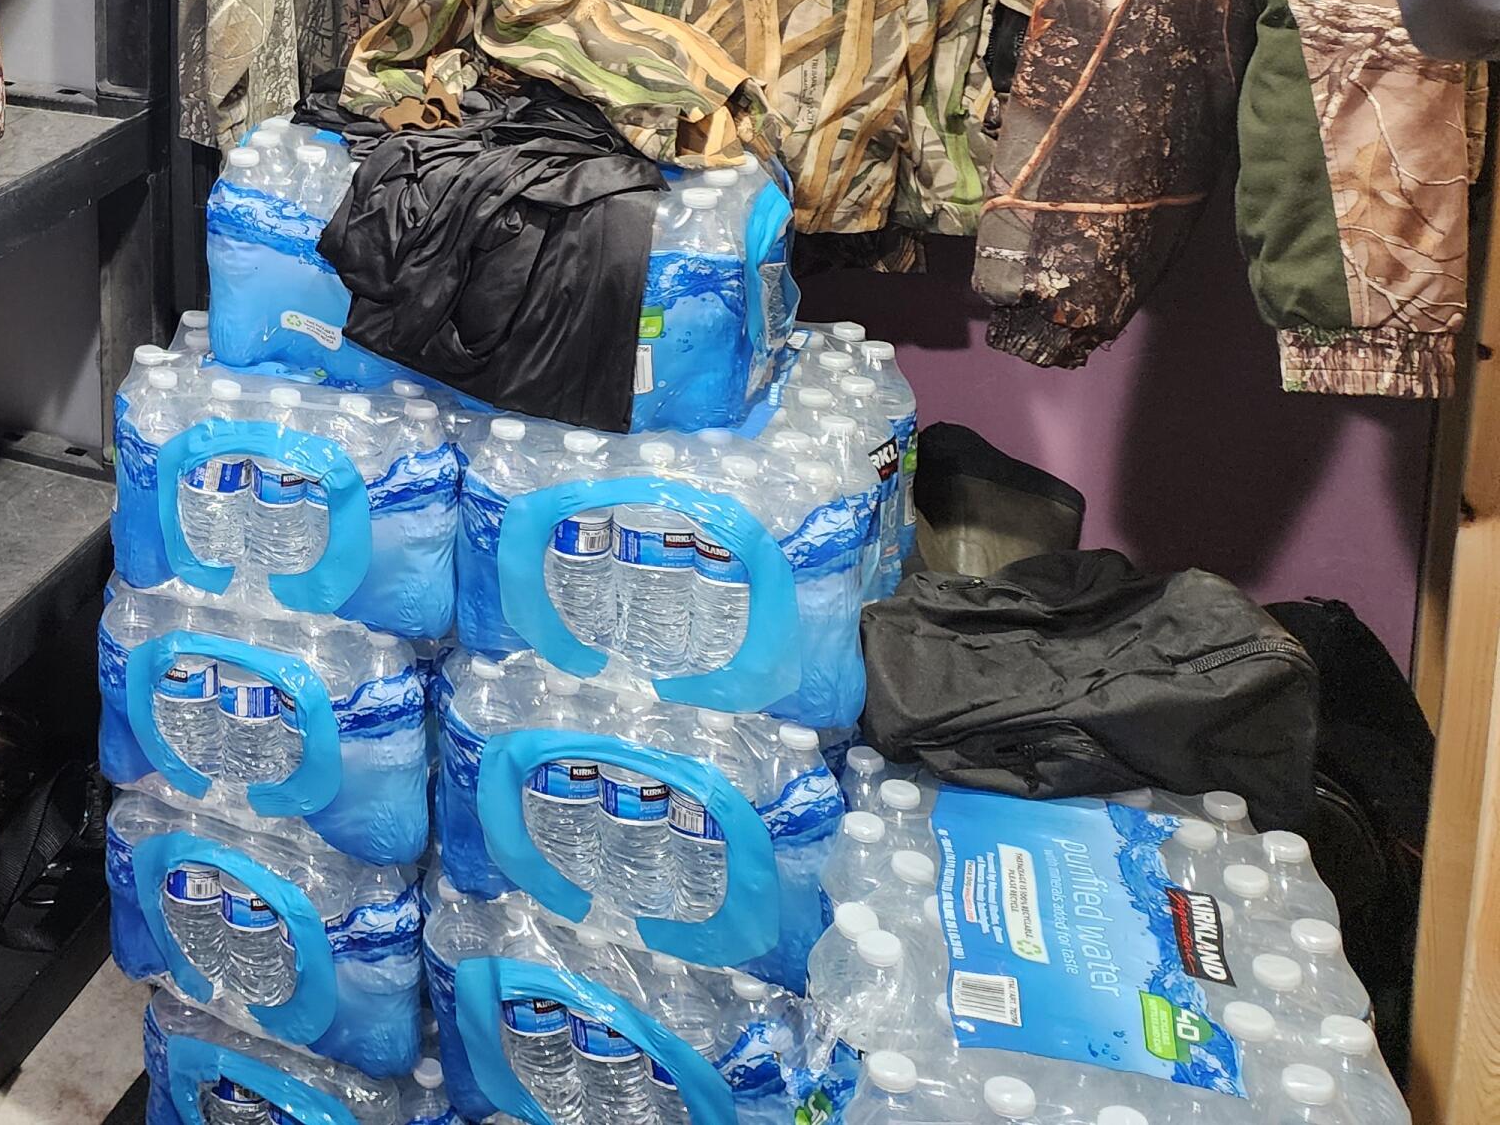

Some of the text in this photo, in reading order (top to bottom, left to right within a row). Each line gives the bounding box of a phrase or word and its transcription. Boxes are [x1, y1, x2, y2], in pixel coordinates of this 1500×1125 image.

[1051, 837, 1122, 997] purified water
[1052, 900, 1070, 929] added
[1056, 928, 1072, 948] for
[1168, 890, 1196, 974] Signature
[1187, 894, 1228, 981] KIRKLAND
[1062, 948, 1079, 975] taste
[1175, 1008, 1200, 1041] 40
